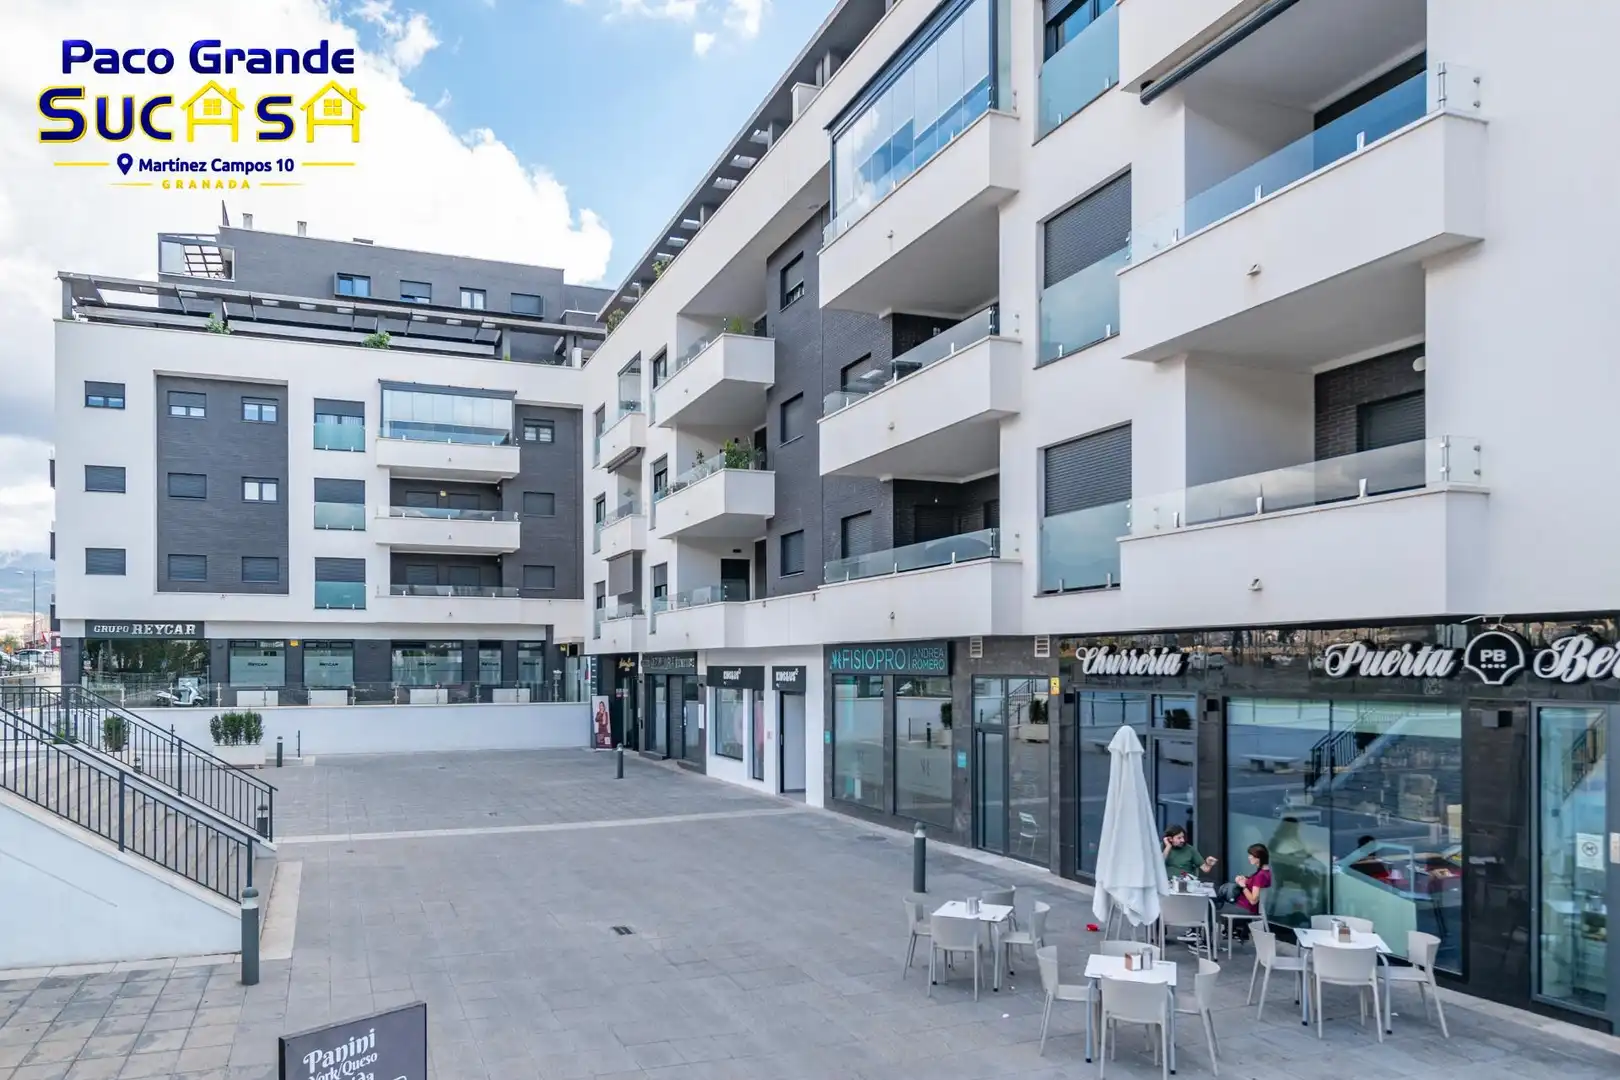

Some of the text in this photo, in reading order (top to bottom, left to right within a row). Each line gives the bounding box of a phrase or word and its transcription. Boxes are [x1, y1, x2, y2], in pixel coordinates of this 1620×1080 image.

[93, 623, 196, 635] GRUPO REYCAR
[842, 647, 906, 670] FISIOPRO
[913, 647, 944, 659] ANDREA
[1324, 641, 1455, 677] Puerta
[1480, 649, 1506, 662] PB
[912, 658, 945, 670] ROMERO
[303, 1028, 376, 1074] Panini
